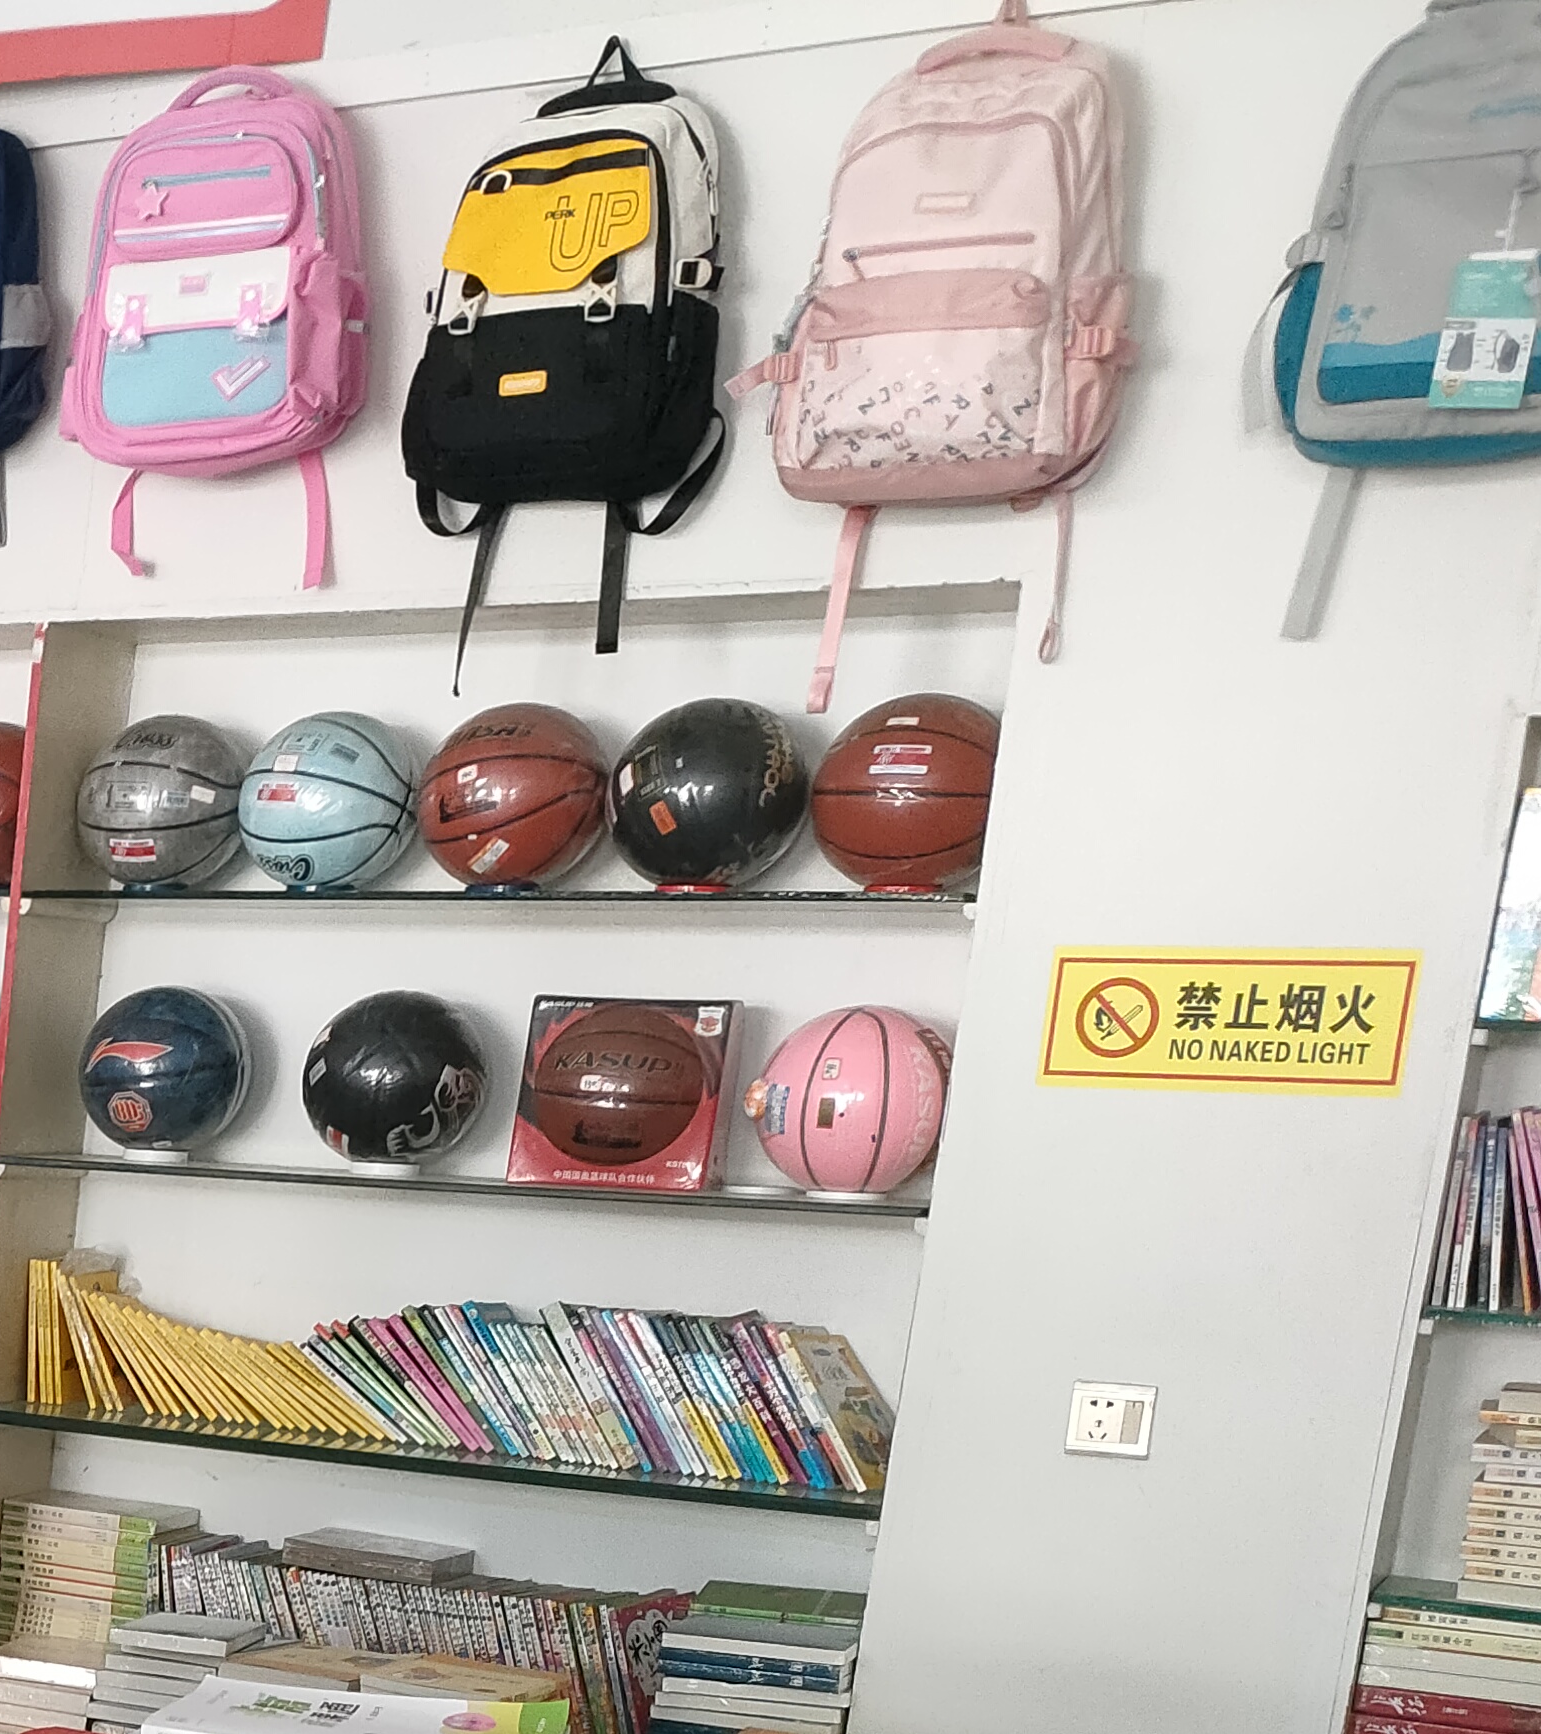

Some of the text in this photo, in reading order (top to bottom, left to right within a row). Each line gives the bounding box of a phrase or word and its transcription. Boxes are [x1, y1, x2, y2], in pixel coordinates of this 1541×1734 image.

[544, 208, 576, 222] PERK
[549, 189, 640, 272] UP
[1173, 980, 1377, 1034] 禁止烟火
[554, 1050, 673, 1073] KASUP
[1168, 1038, 1372, 1065] NO NAKED LIGHT
